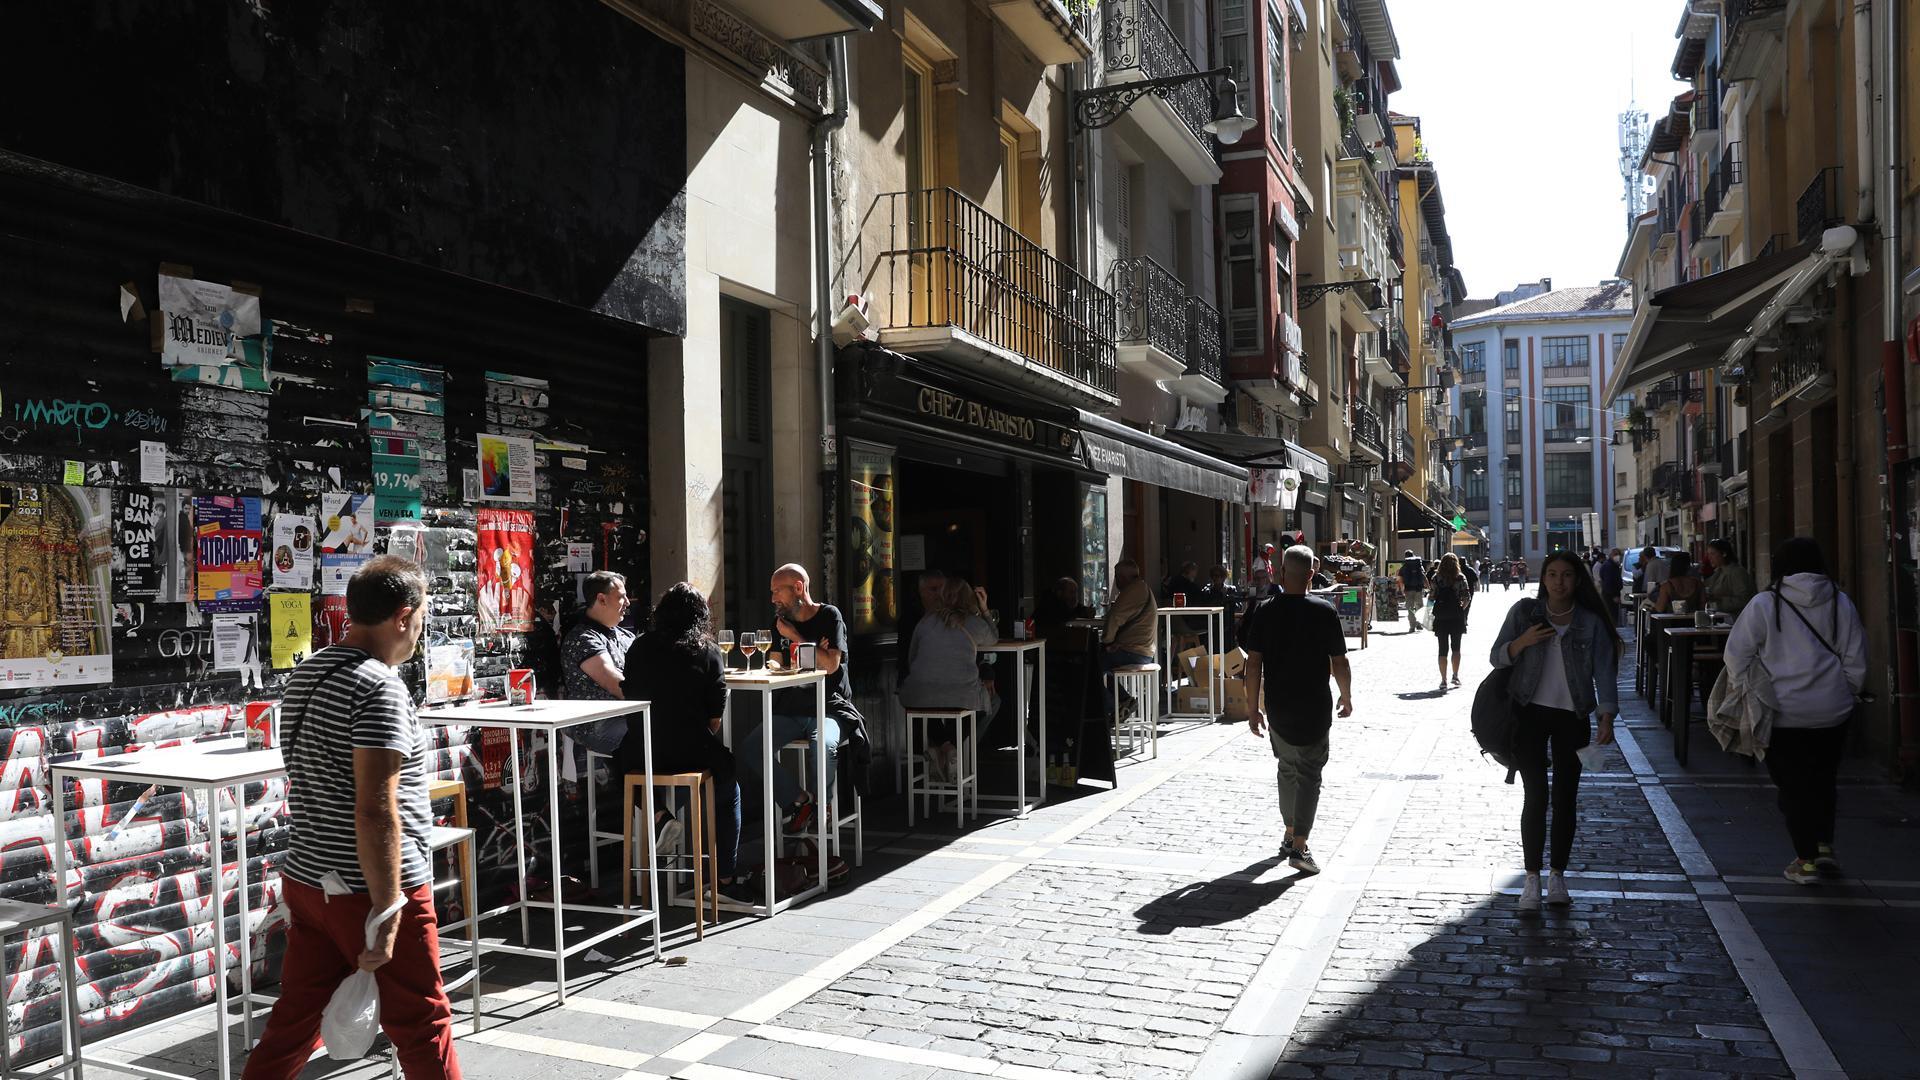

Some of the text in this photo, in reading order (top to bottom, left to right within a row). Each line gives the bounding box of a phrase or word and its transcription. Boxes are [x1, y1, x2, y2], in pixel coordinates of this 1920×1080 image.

[919, 387, 1035, 441] CHEZ EVARISTO
[1102, 450, 1126, 468] EVARISTO
[129, 493, 150, 510] UR
[124, 507, 154, 527] BAN
[379, 509, 393, 518] VEN
[394, 510, 400, 518] A
[124, 528, 156, 544] DAN
[128, 544, 150, 559] CE
[280, 600, 303, 609] YOGA
